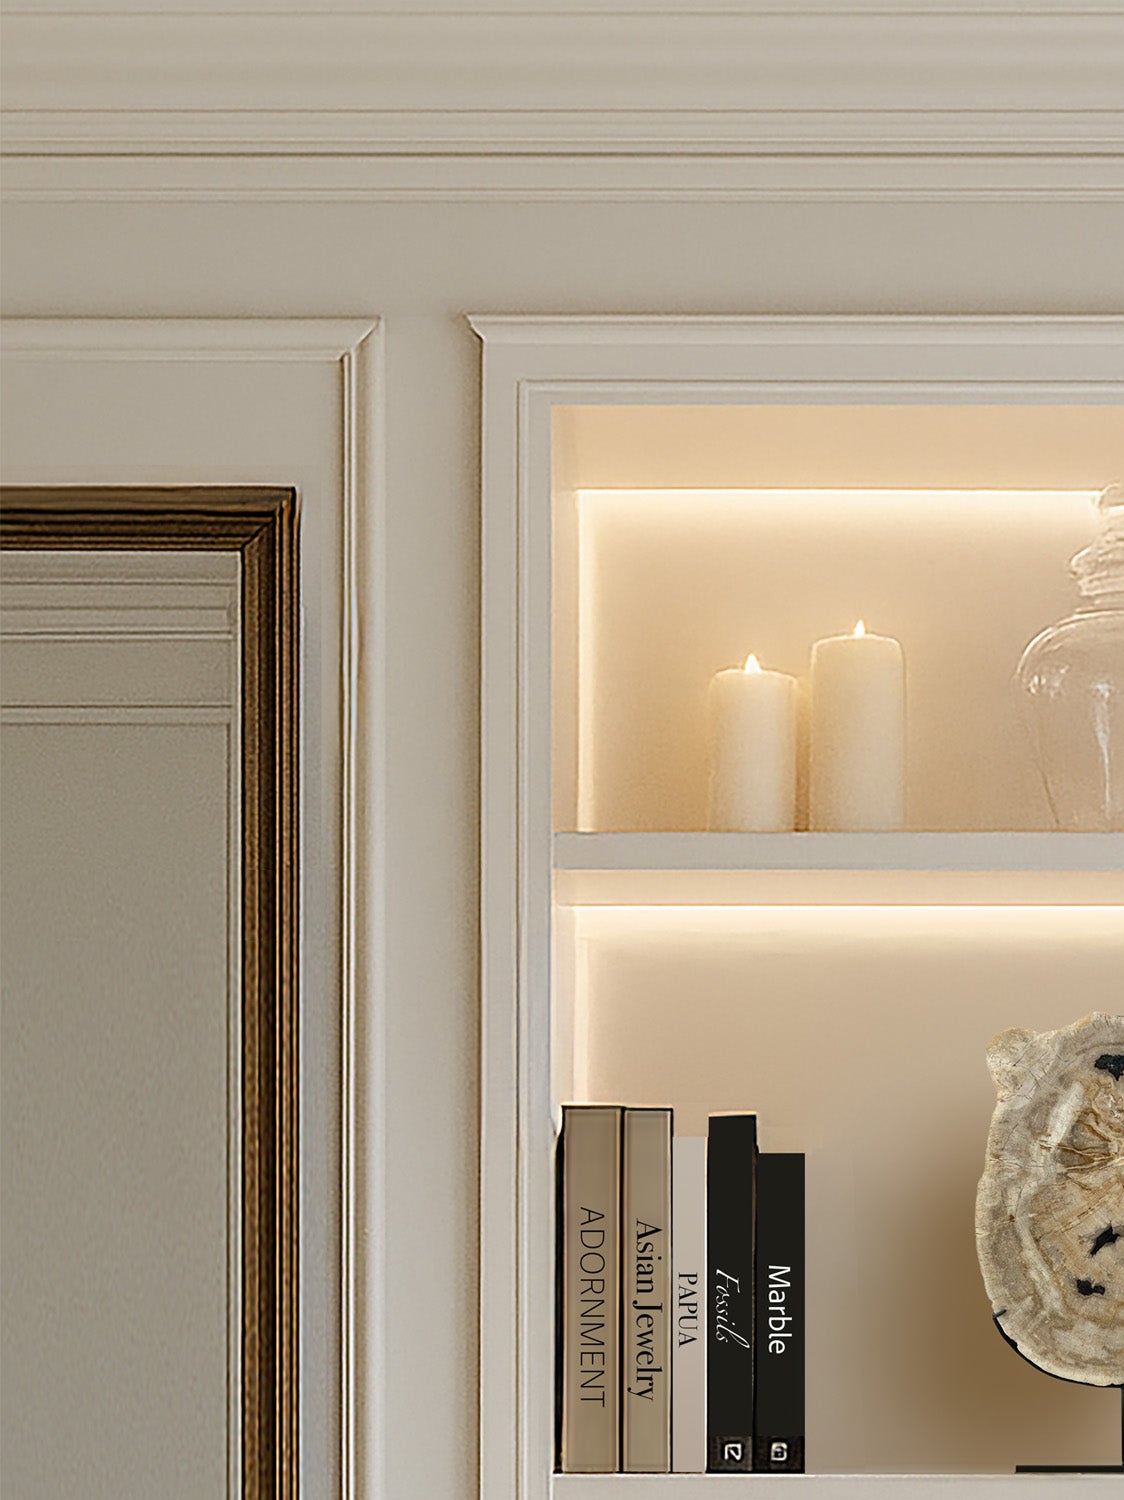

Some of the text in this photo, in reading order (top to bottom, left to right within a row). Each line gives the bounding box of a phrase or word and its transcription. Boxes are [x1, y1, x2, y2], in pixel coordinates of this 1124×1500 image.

[579, 1206, 606, 1408] ADORNMENT
[627, 1217, 663, 1402] Asian Jewelry
[678, 1271, 699, 1349] PAPUA
[715, 1268, 750, 1349] Fossils
[768, 1264, 793, 1355] Marble
